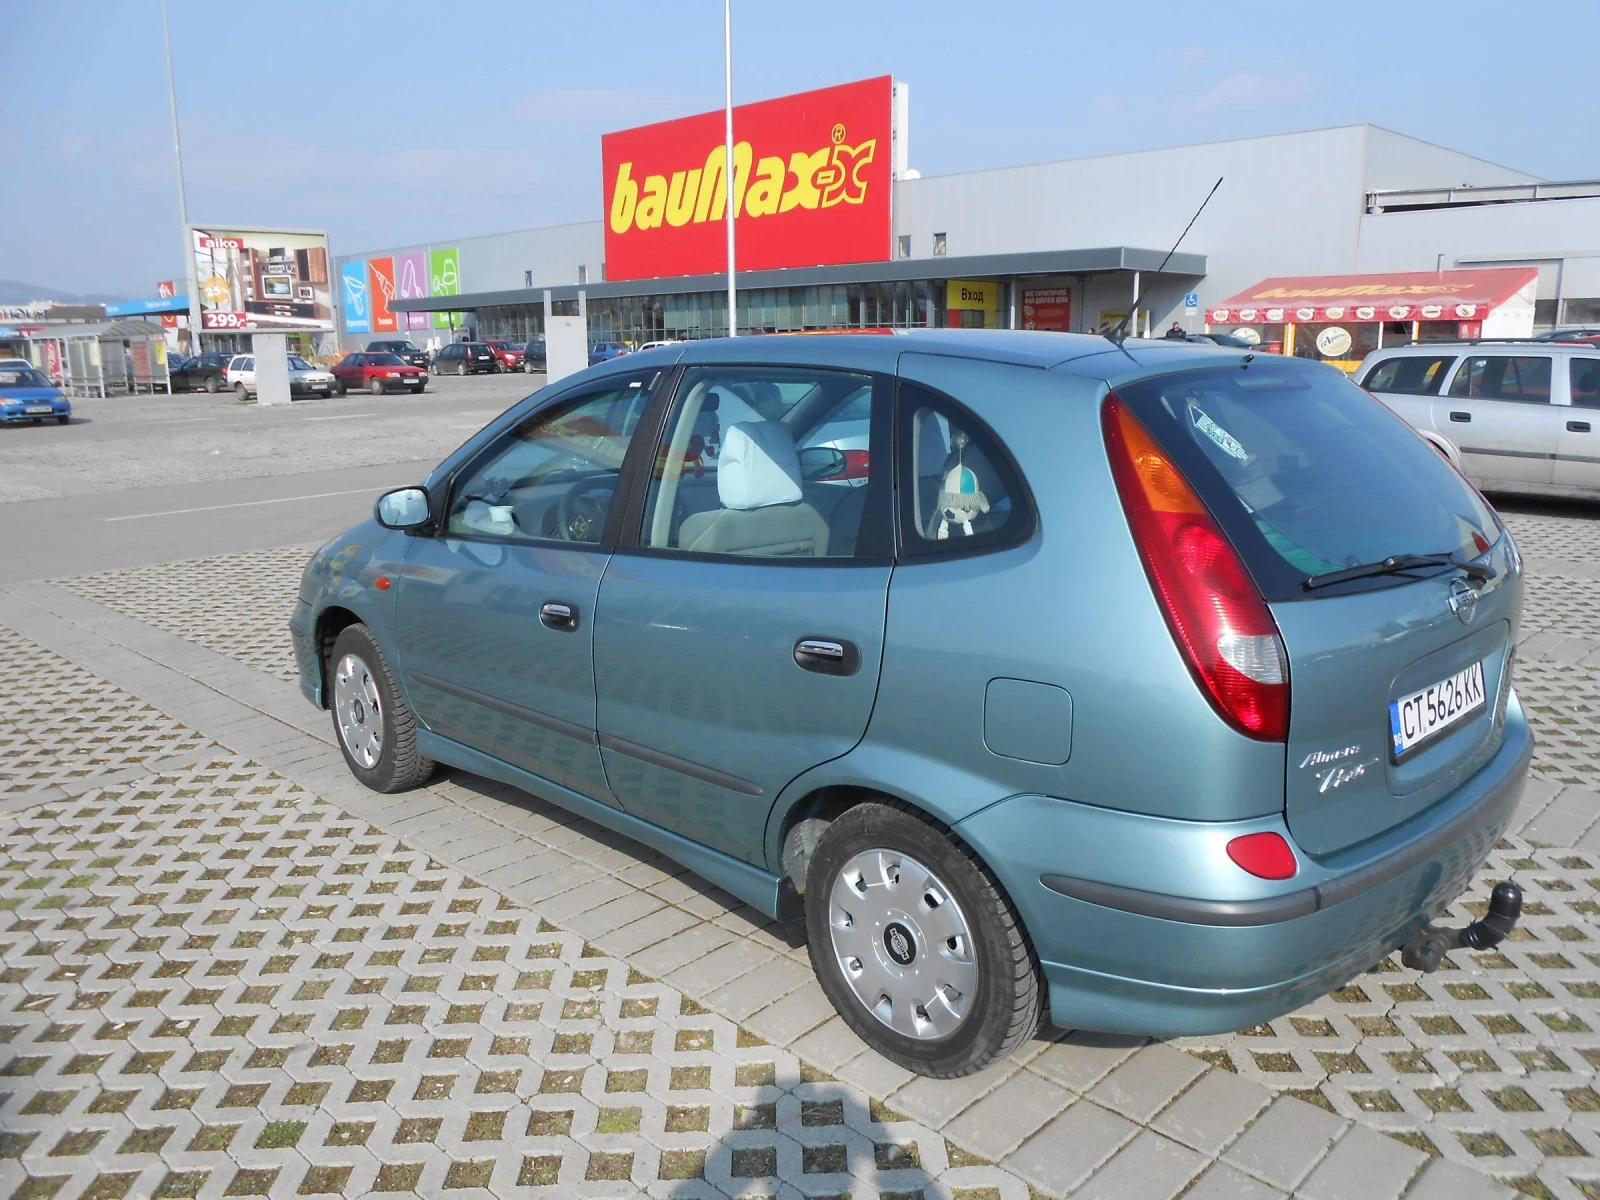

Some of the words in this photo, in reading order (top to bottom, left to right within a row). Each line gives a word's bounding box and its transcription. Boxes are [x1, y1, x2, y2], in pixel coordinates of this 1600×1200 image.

[205, 238, 239, 249] aiko
[961, 287, 984, 303] Вход
[1393, 732, 1403, 747] BG
